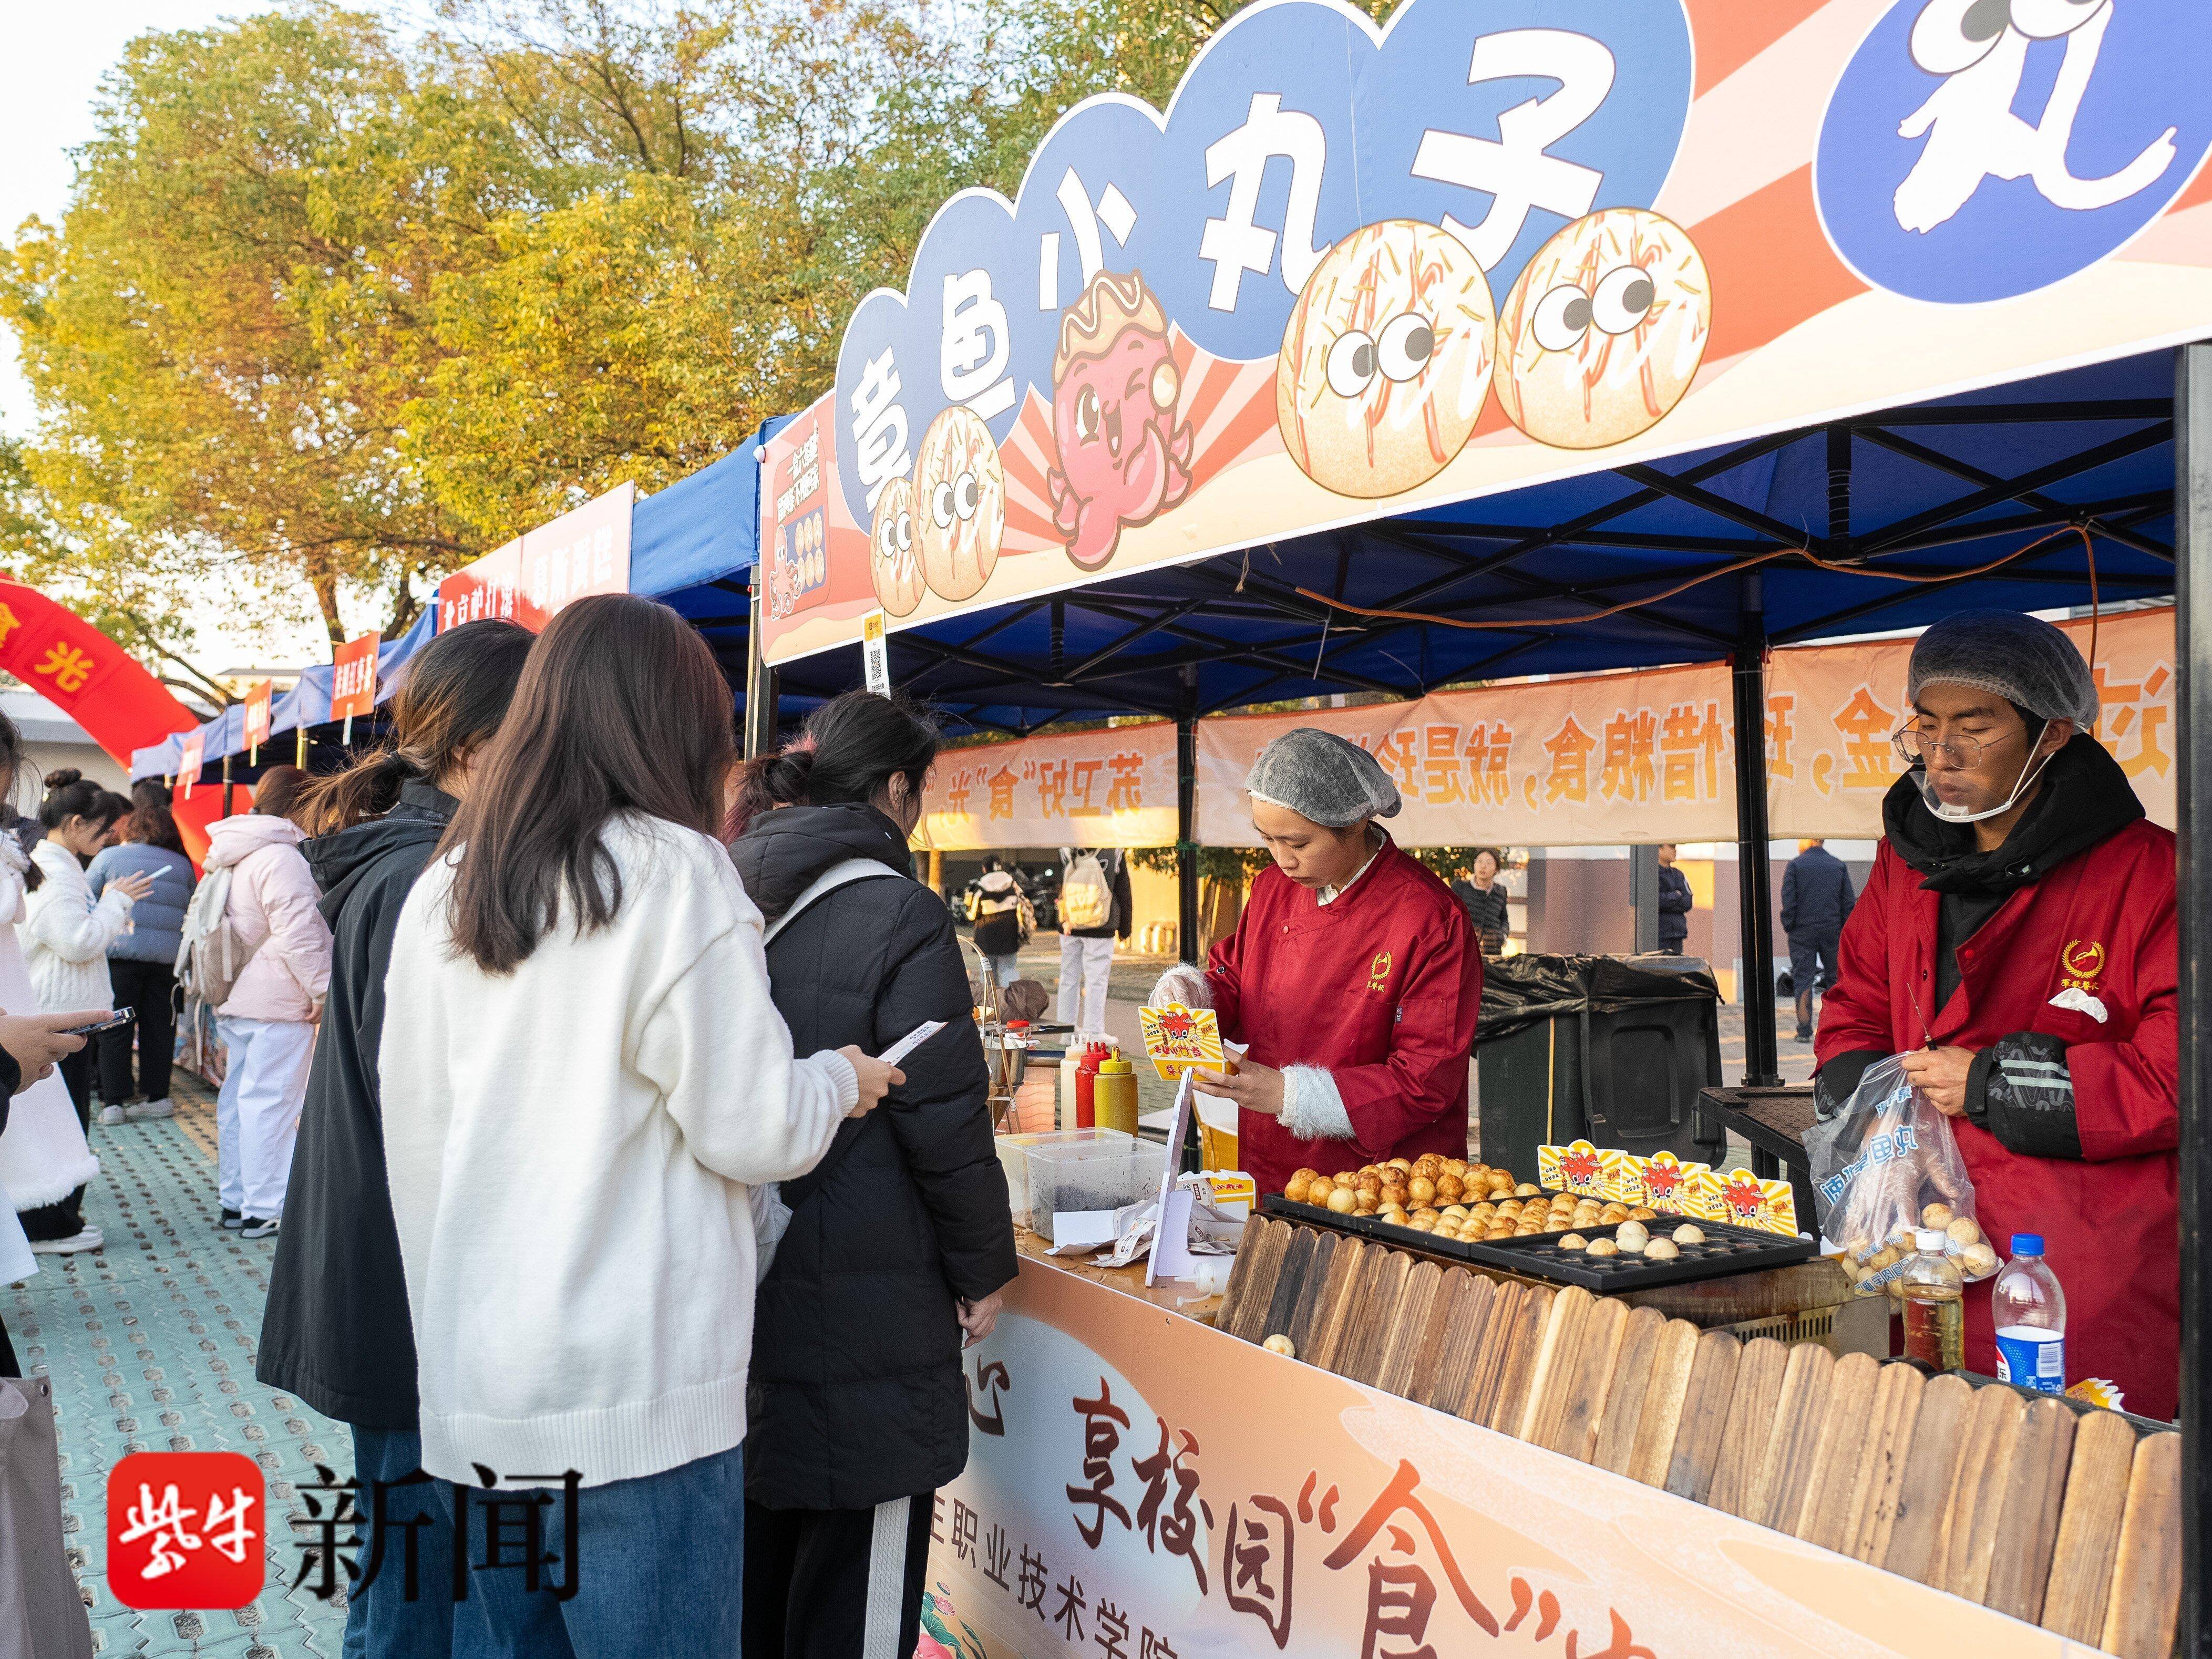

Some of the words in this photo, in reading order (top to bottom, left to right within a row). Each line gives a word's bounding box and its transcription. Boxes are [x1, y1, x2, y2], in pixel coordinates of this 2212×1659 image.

[1885, 1233, 1904, 1245] 1kg
[1066, 1375, 1657, 1659] 享校园“食”
